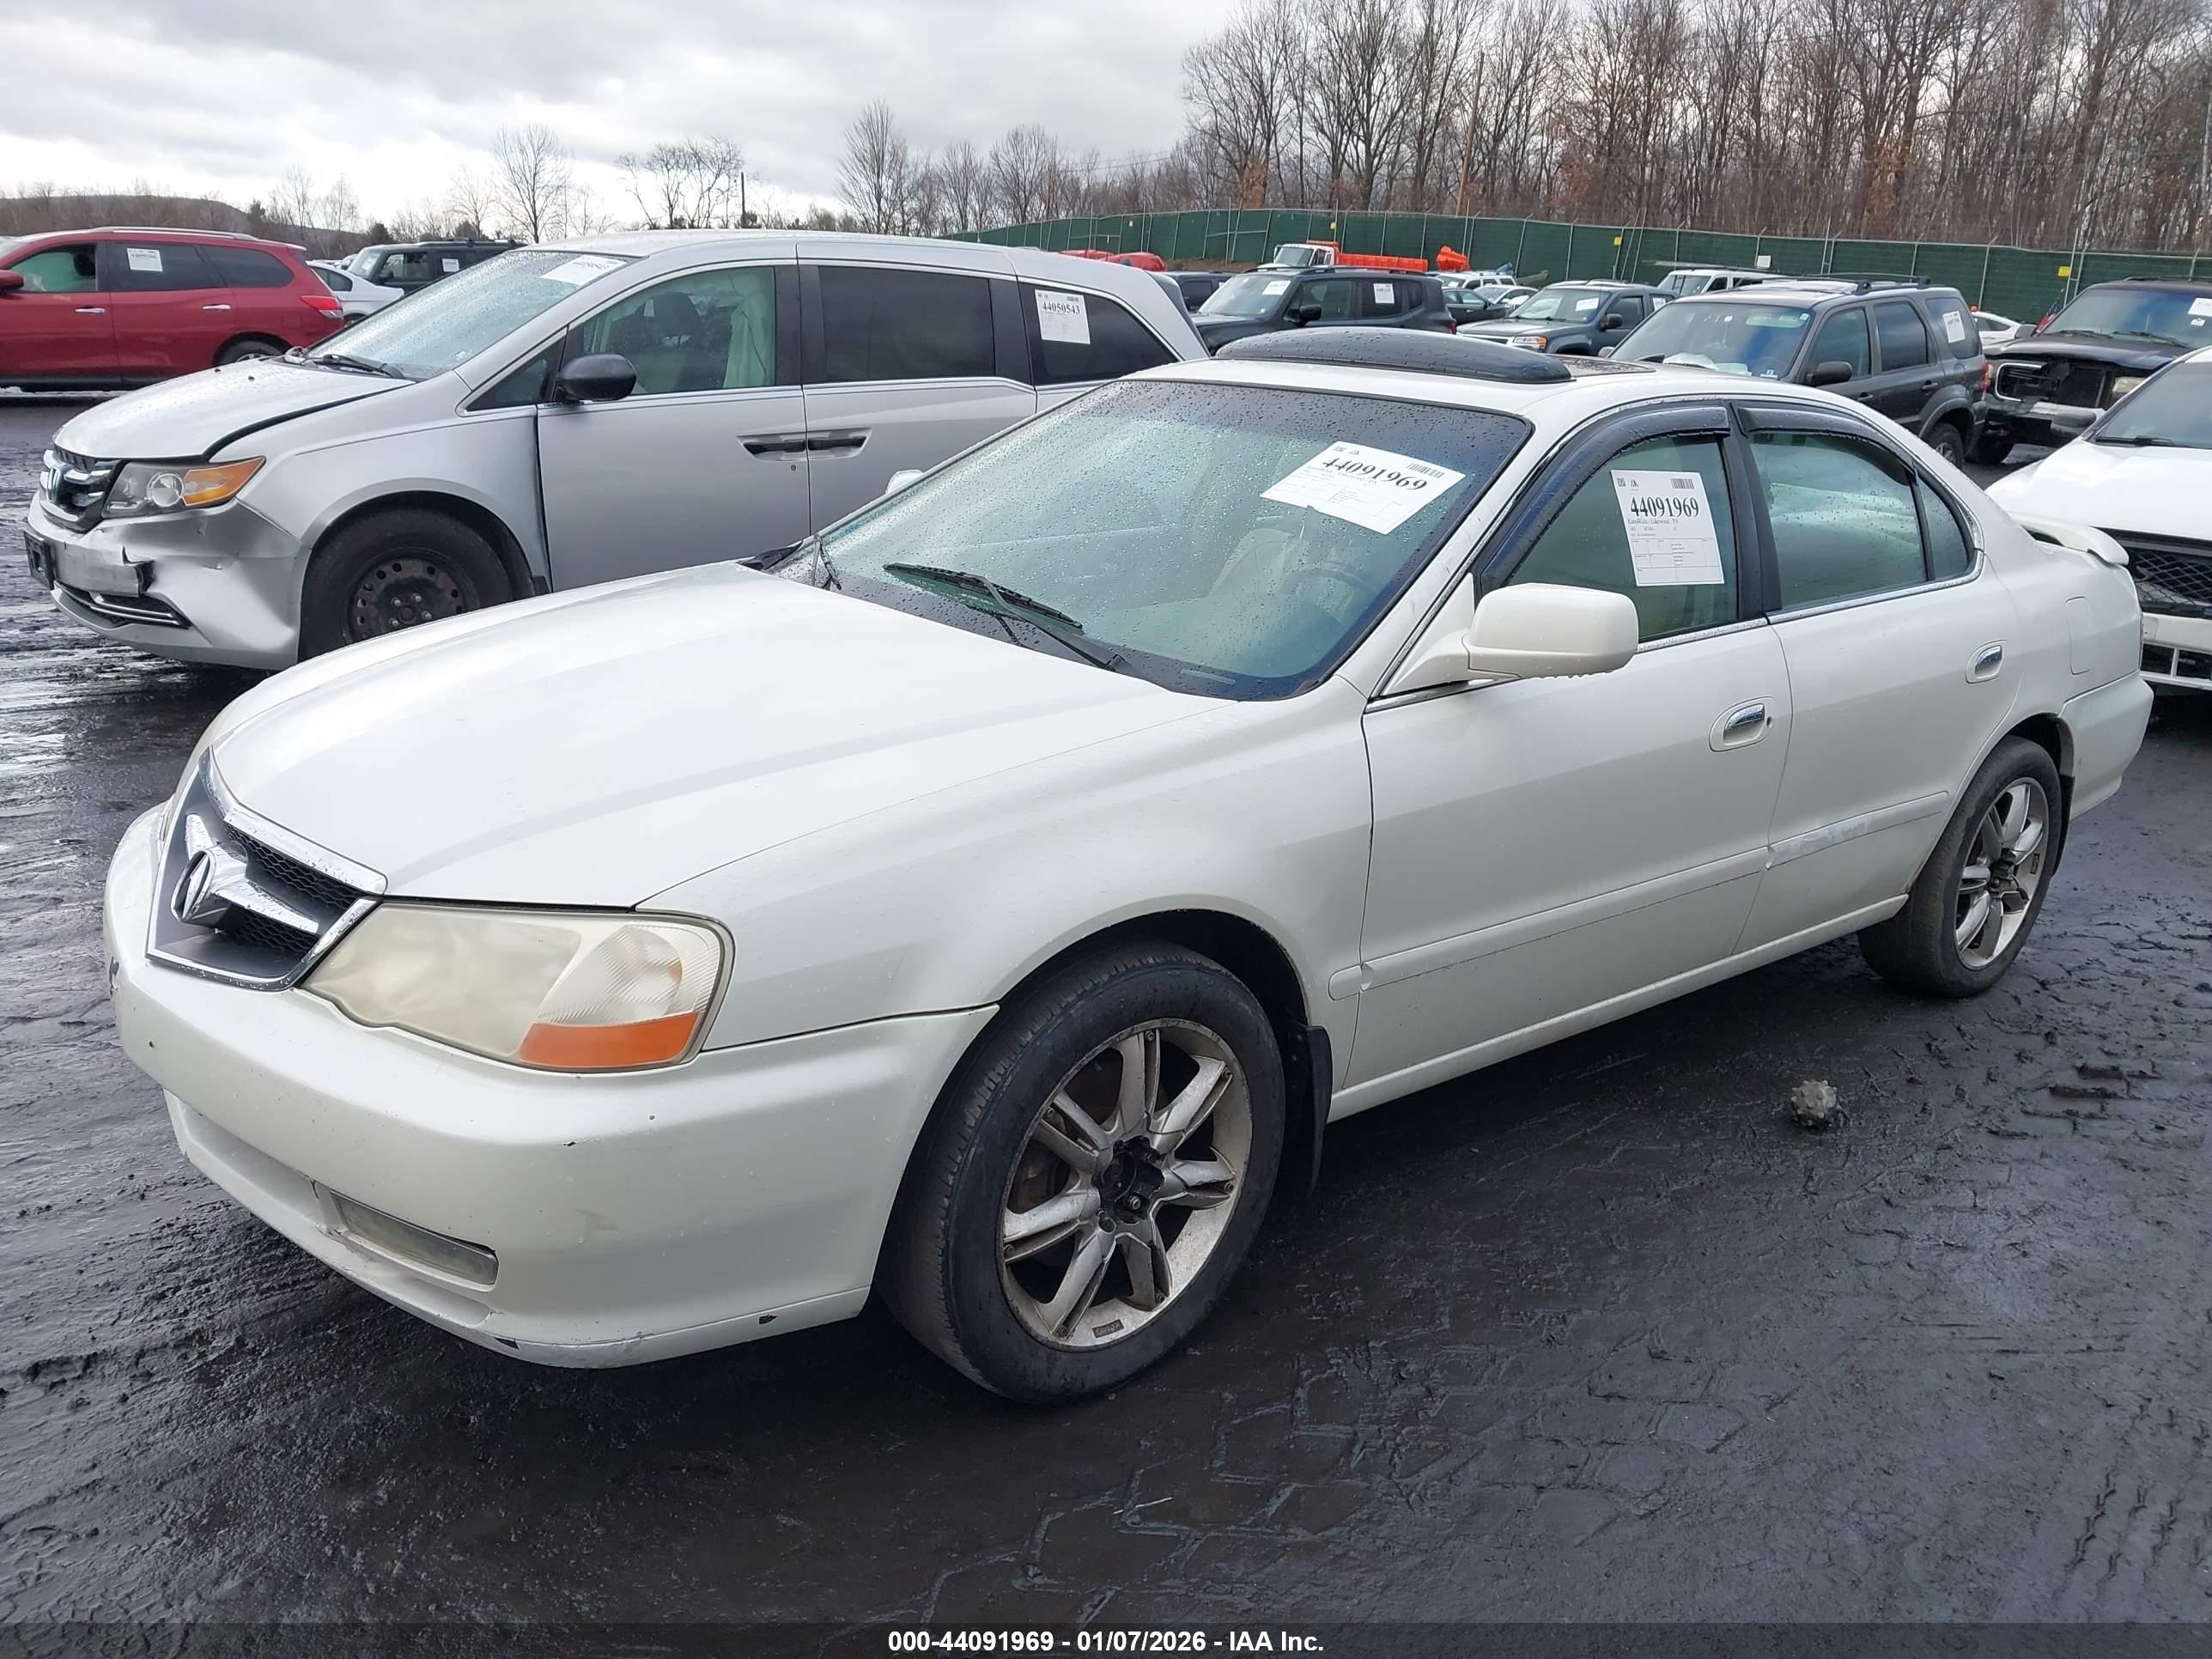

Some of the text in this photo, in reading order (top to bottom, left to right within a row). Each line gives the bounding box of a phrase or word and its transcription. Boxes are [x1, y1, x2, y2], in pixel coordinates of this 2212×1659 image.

[1042, 301, 1080, 314] 44050543
[1322, 457, 1428, 490] 44091969
[1631, 496, 1699, 517] 44091969
